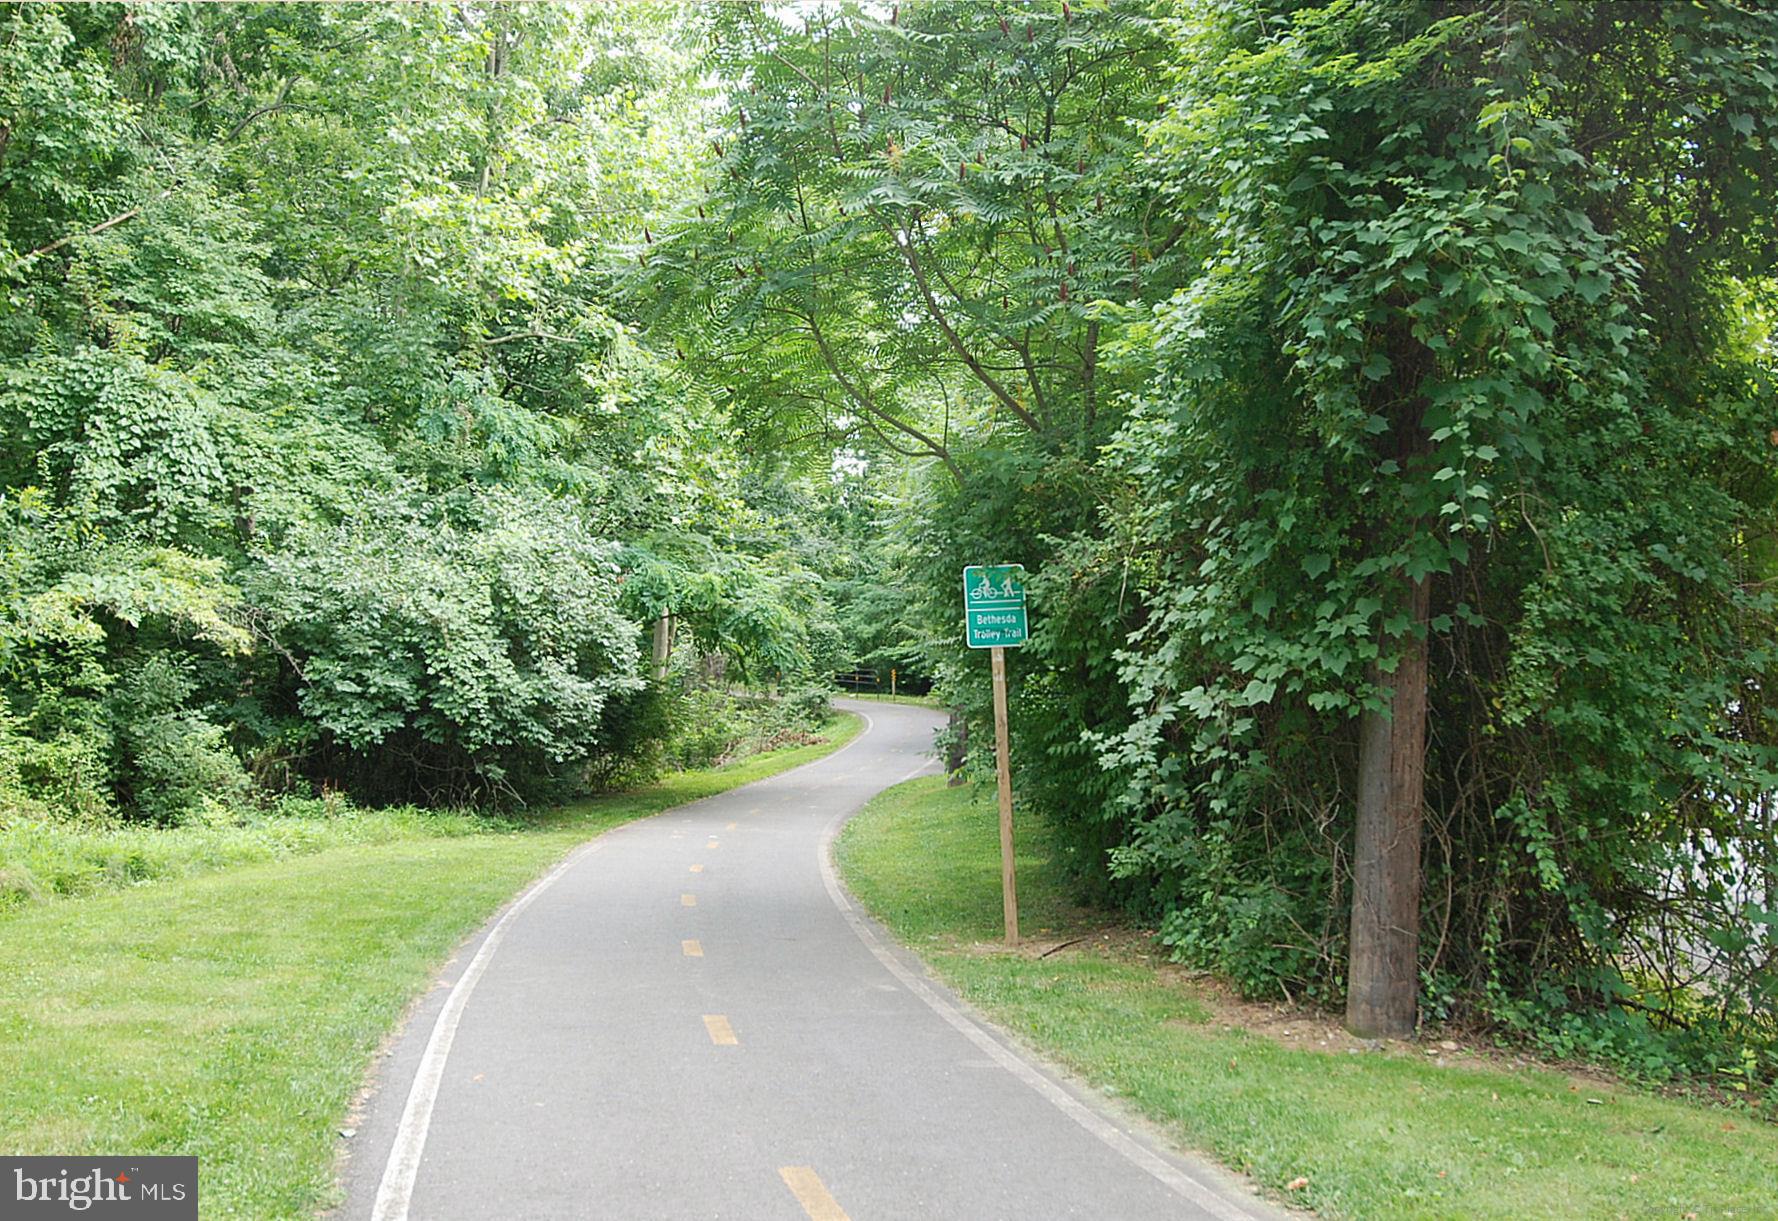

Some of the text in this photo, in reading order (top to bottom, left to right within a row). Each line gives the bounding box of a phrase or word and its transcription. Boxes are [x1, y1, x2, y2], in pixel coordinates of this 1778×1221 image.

[976, 613, 1017, 625] Bethesda
[973, 627, 1022, 641] Trolley Trail
